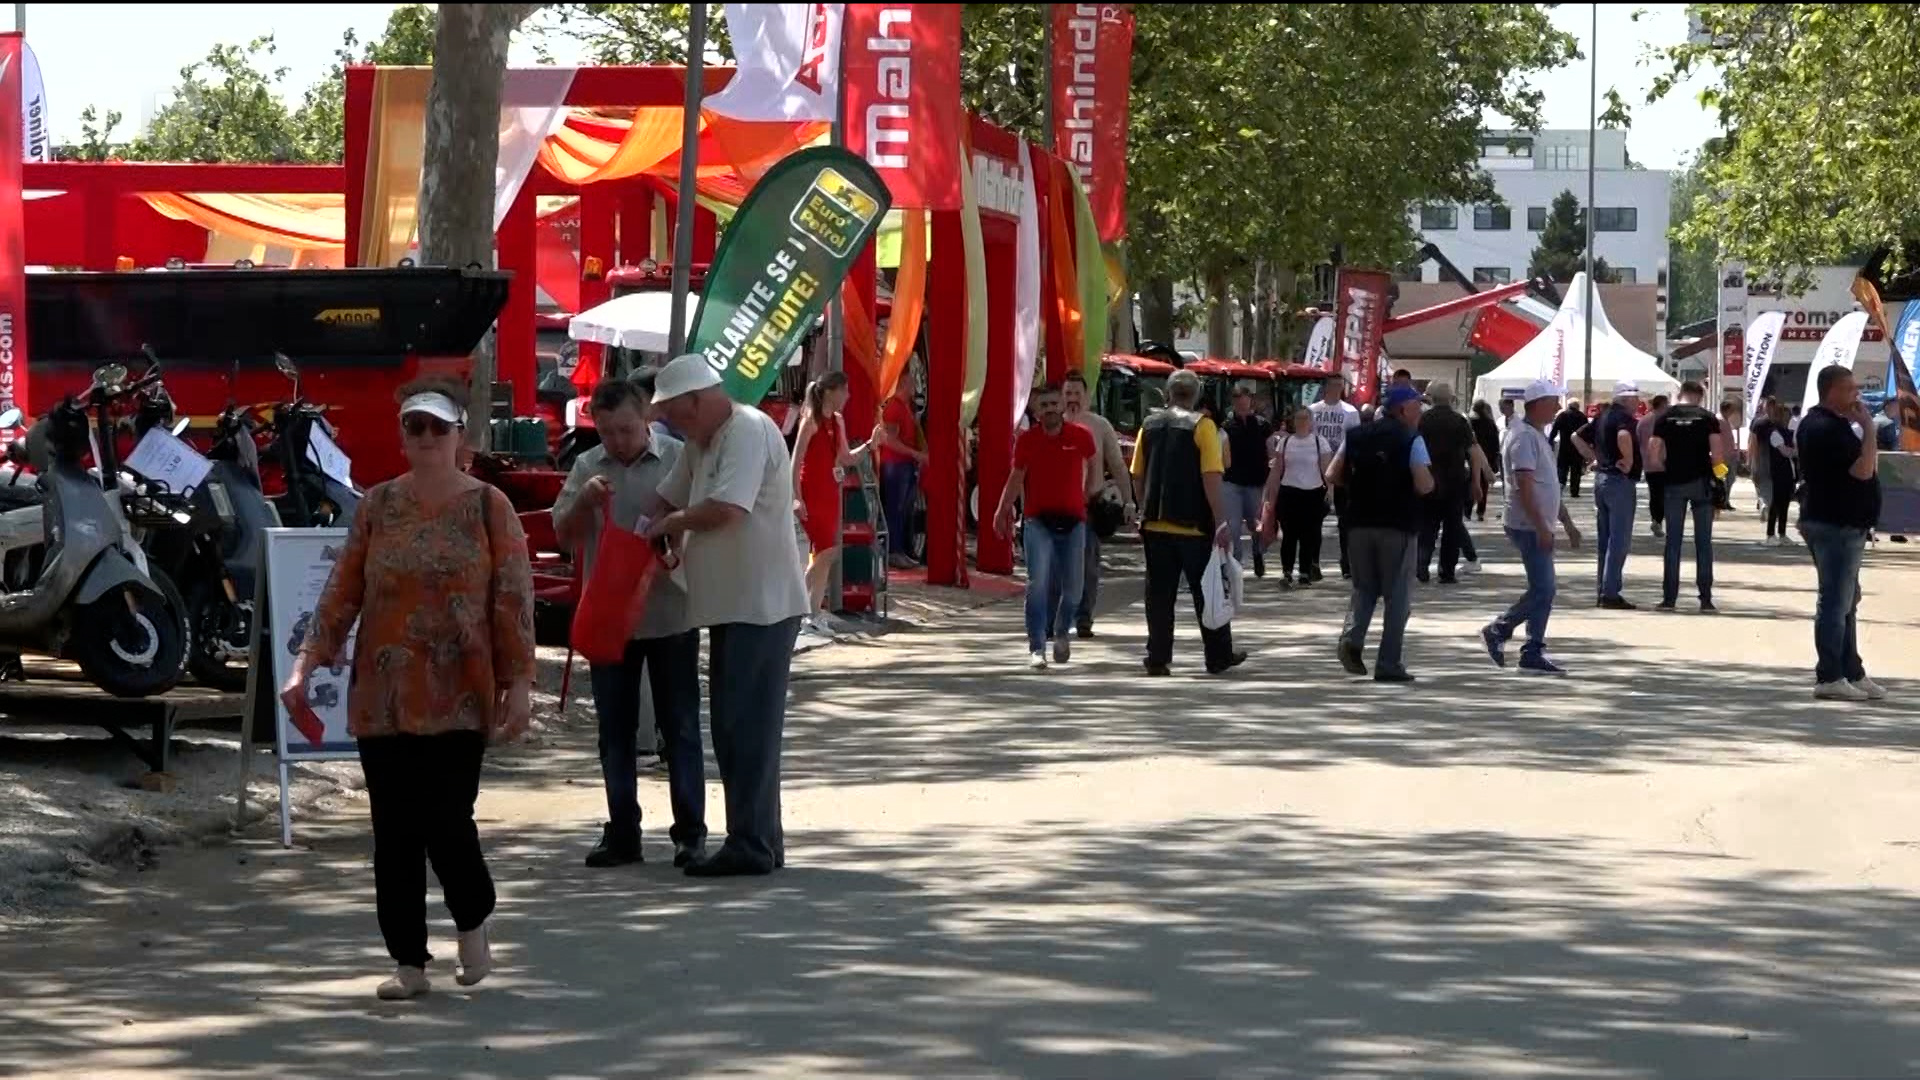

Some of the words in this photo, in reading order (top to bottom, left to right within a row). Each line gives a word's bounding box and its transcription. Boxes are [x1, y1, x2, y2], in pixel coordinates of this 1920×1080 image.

[800, 209, 847, 249] Petrol
[808, 195, 847, 228] Euro
[703, 280, 776, 372] ČLANITE
[766, 249, 798, 283] SE
[788, 236, 808, 252] I
[736, 270, 821, 381] UŠTEDITE!
